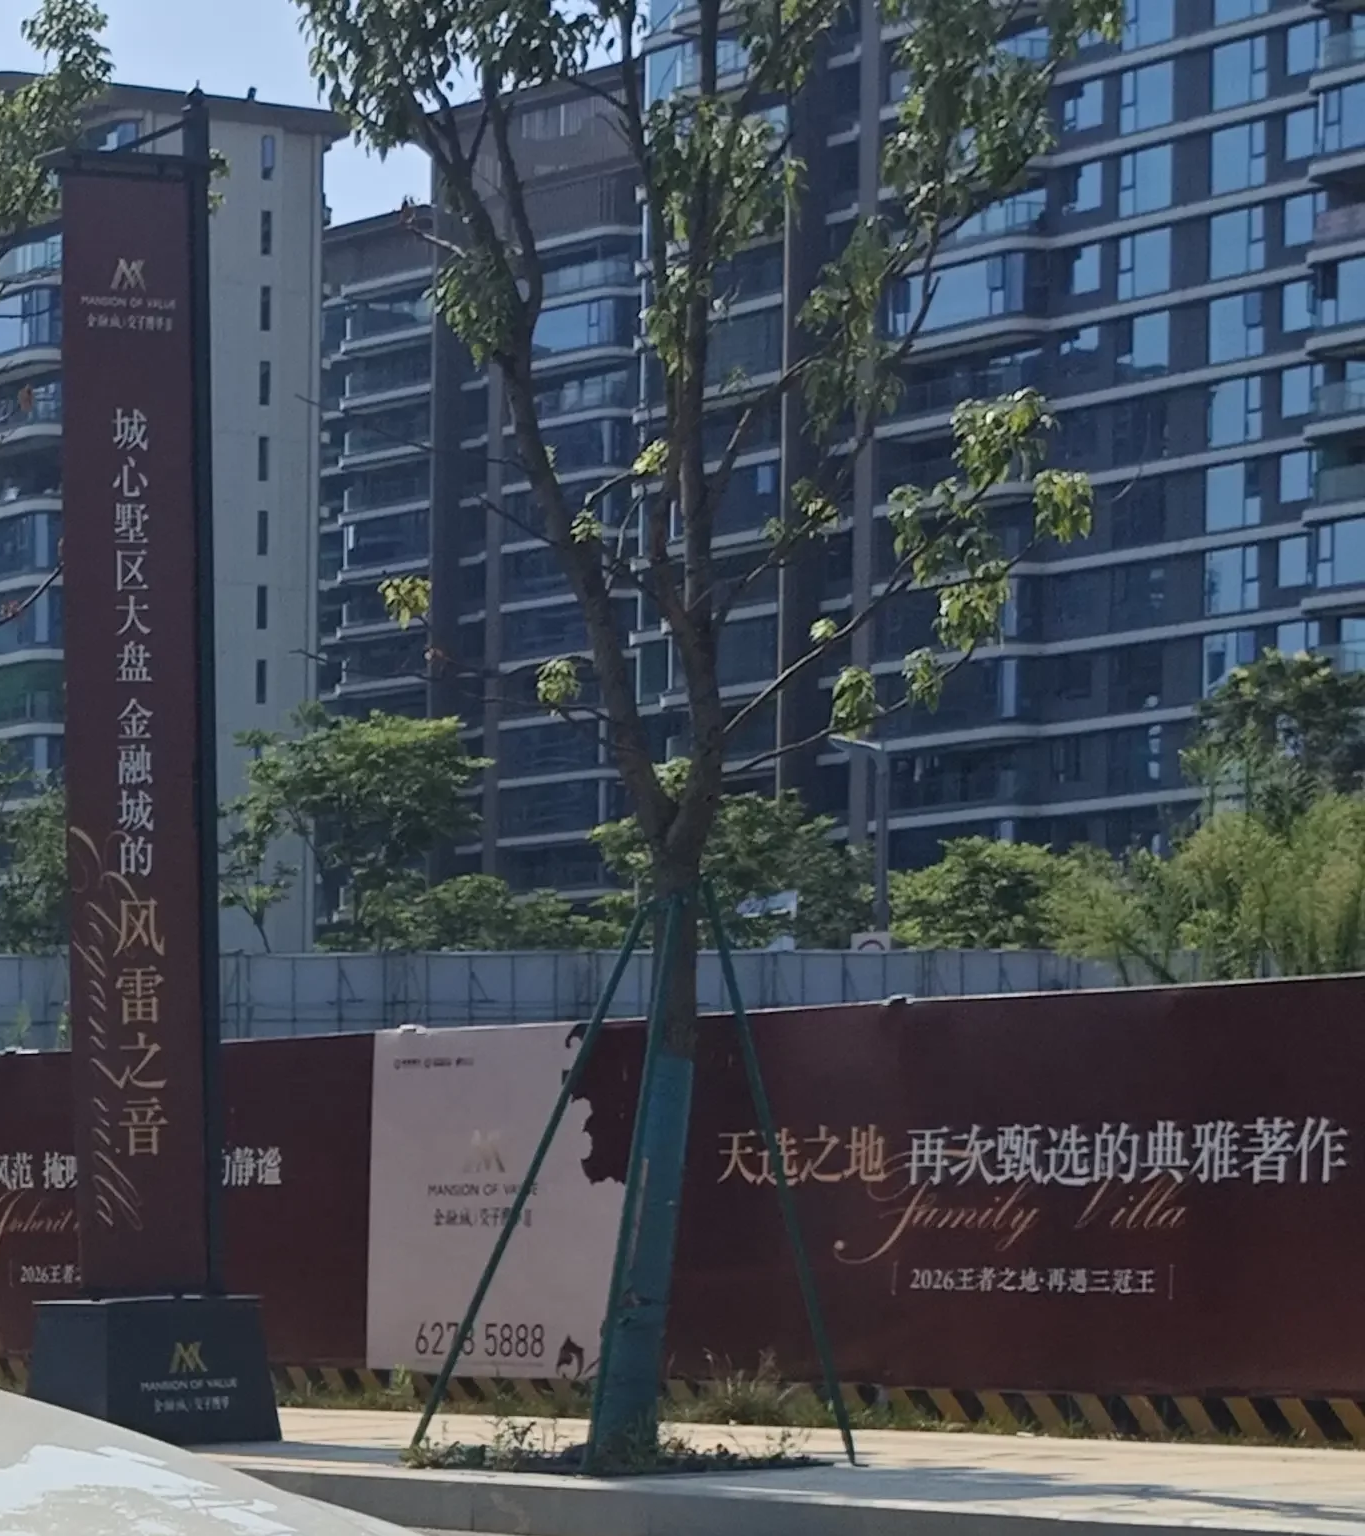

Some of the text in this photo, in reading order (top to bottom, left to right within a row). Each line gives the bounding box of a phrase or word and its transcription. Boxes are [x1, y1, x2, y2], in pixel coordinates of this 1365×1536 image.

[111, 407, 168, 1157] 城心墅区大盘 金融城的 风雷之音
[717, 1116, 1349, 1186] 天选之地 再次甄选的典雅著作
[484, 1322, 546, 1358] 5888
